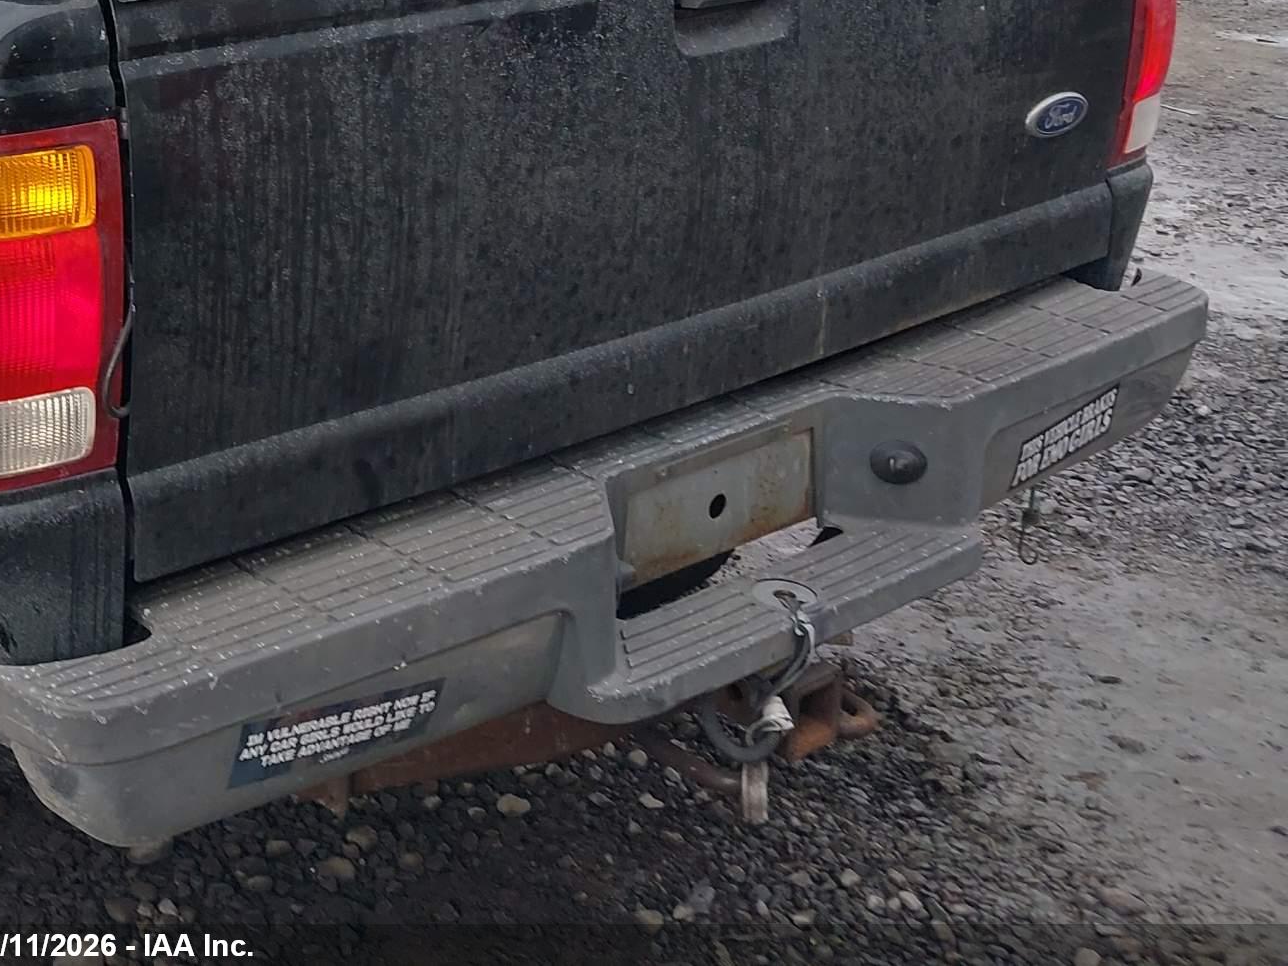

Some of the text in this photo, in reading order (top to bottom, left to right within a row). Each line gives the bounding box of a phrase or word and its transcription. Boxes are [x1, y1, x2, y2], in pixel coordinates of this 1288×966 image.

[1044, 103, 1077, 129] Ford
[1044, 411, 1082, 447] VEHICLE
[1080, 388, 1118, 425] BRAKES
[1011, 408, 1113, 486] FOR EMO GIRLS
[238, 747, 268, 761] ANY
[299, 727, 341, 744] GIRLS
[342, 716, 385, 732] WOULD
[385, 708, 417, 722] LIKE
[418, 701, 436, 714] TO
[260, 749, 297, 767] TAKE
[297, 730, 374, 757] ADVANTAGE
[373, 725, 393, 736] OF
[392, 719, 413, 730] ME
[266, 712, 352, 741] VULNERABLE
[352, 702, 393, 721] RIGHT
[393, 695, 420, 710] NOW
